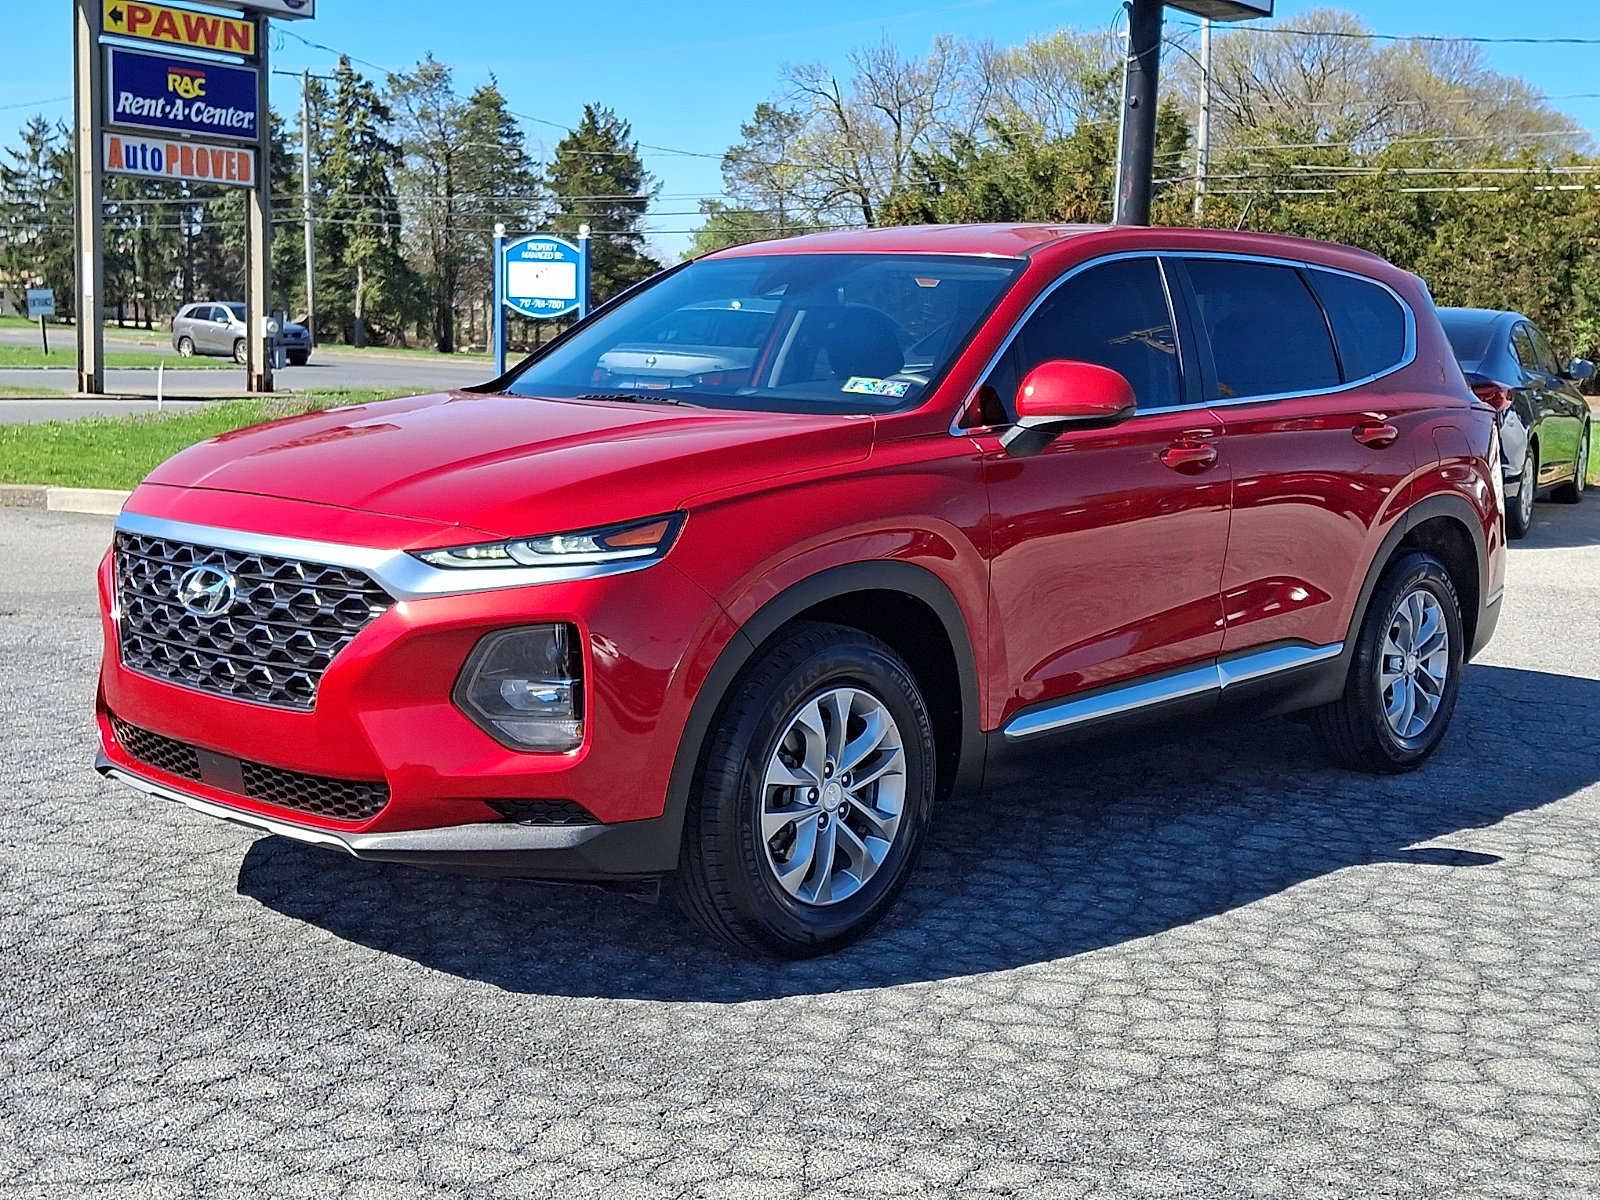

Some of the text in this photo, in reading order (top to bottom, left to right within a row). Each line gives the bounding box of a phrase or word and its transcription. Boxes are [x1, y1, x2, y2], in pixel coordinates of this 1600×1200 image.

[127, 4, 249, 51] PAWN
[168, 73, 206, 99] RAC
[527, 242, 558, 251] PROPERTY
[521, 251, 553, 260] MANAGED
